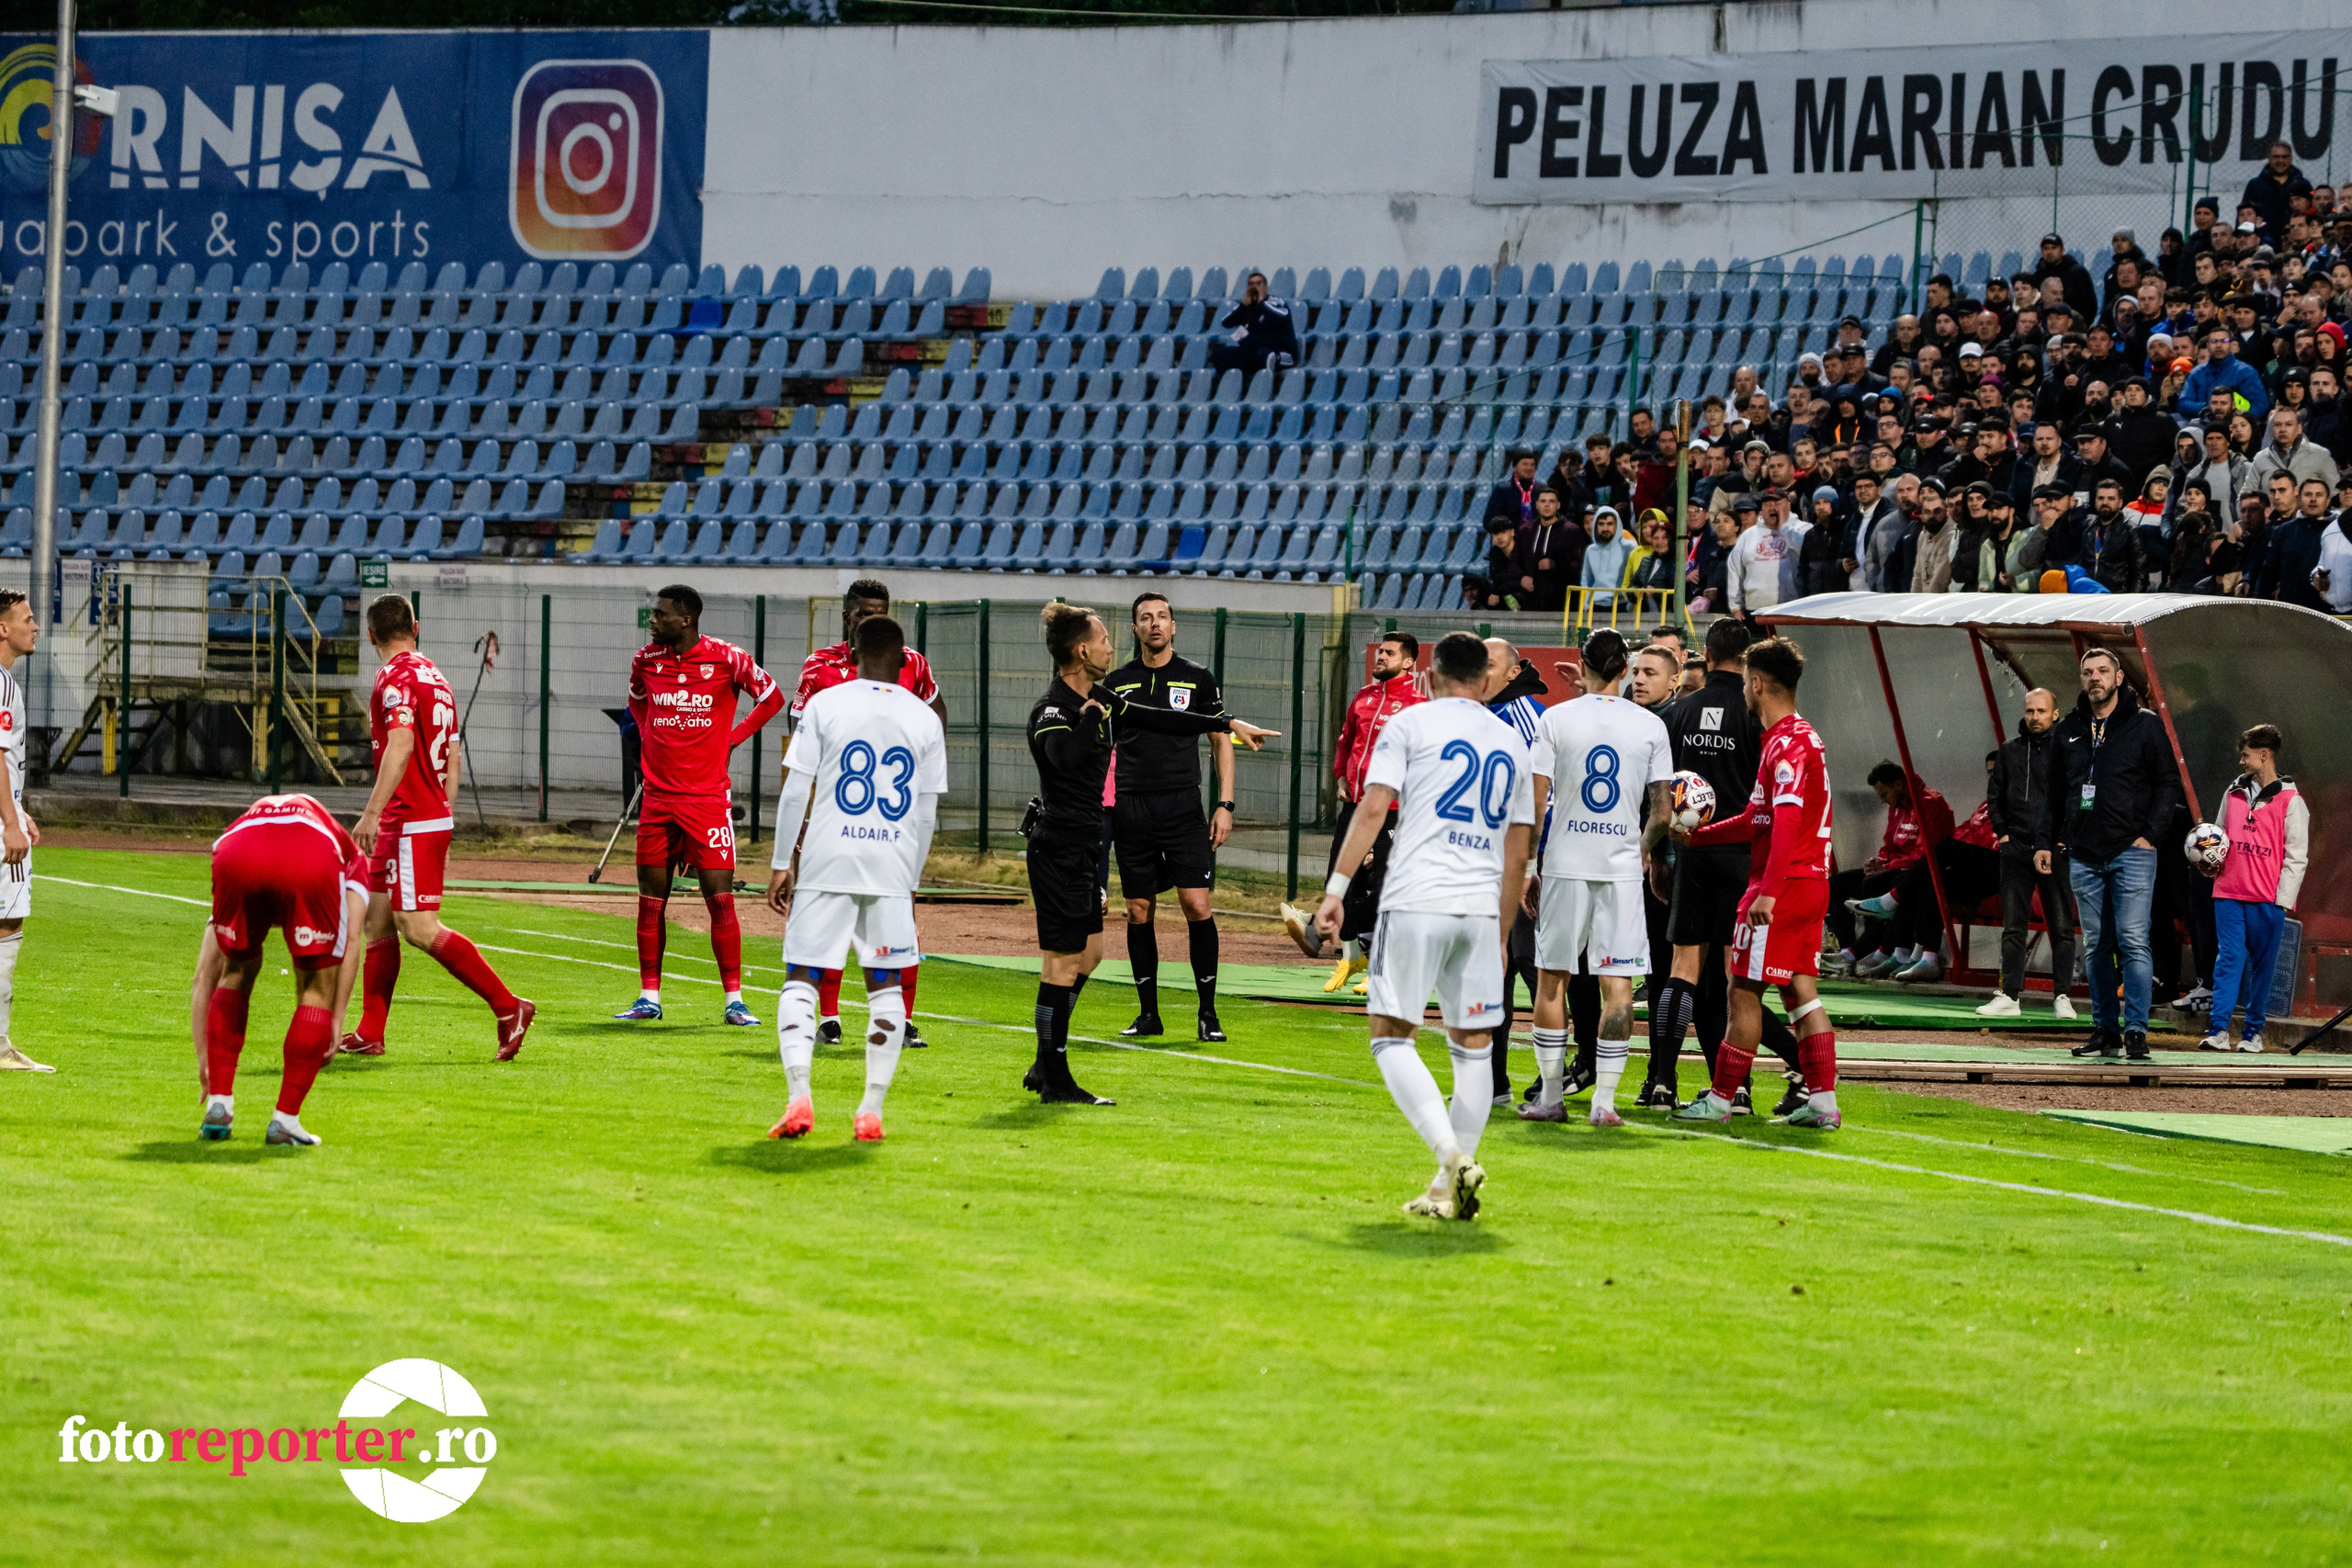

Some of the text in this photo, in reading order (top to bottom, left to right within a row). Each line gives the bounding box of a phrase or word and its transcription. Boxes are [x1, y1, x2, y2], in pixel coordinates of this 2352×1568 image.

[1494, 57, 2339, 178] PELUZA MARIAN CRUDU
[206, 211, 238, 257] &
[266, 209, 430, 265] sports
[652, 689, 713, 708] WIN2.RO
[1683, 734, 1736, 750] NORDIS
[835, 739, 915, 822] 83
[1435, 739, 1516, 829] 20
[1581, 744, 1621, 814] 8
[707, 826, 731, 848] 28
[841, 826, 900, 842] ALDAIR.F
[1567, 820, 1627, 836] FLORESCU
